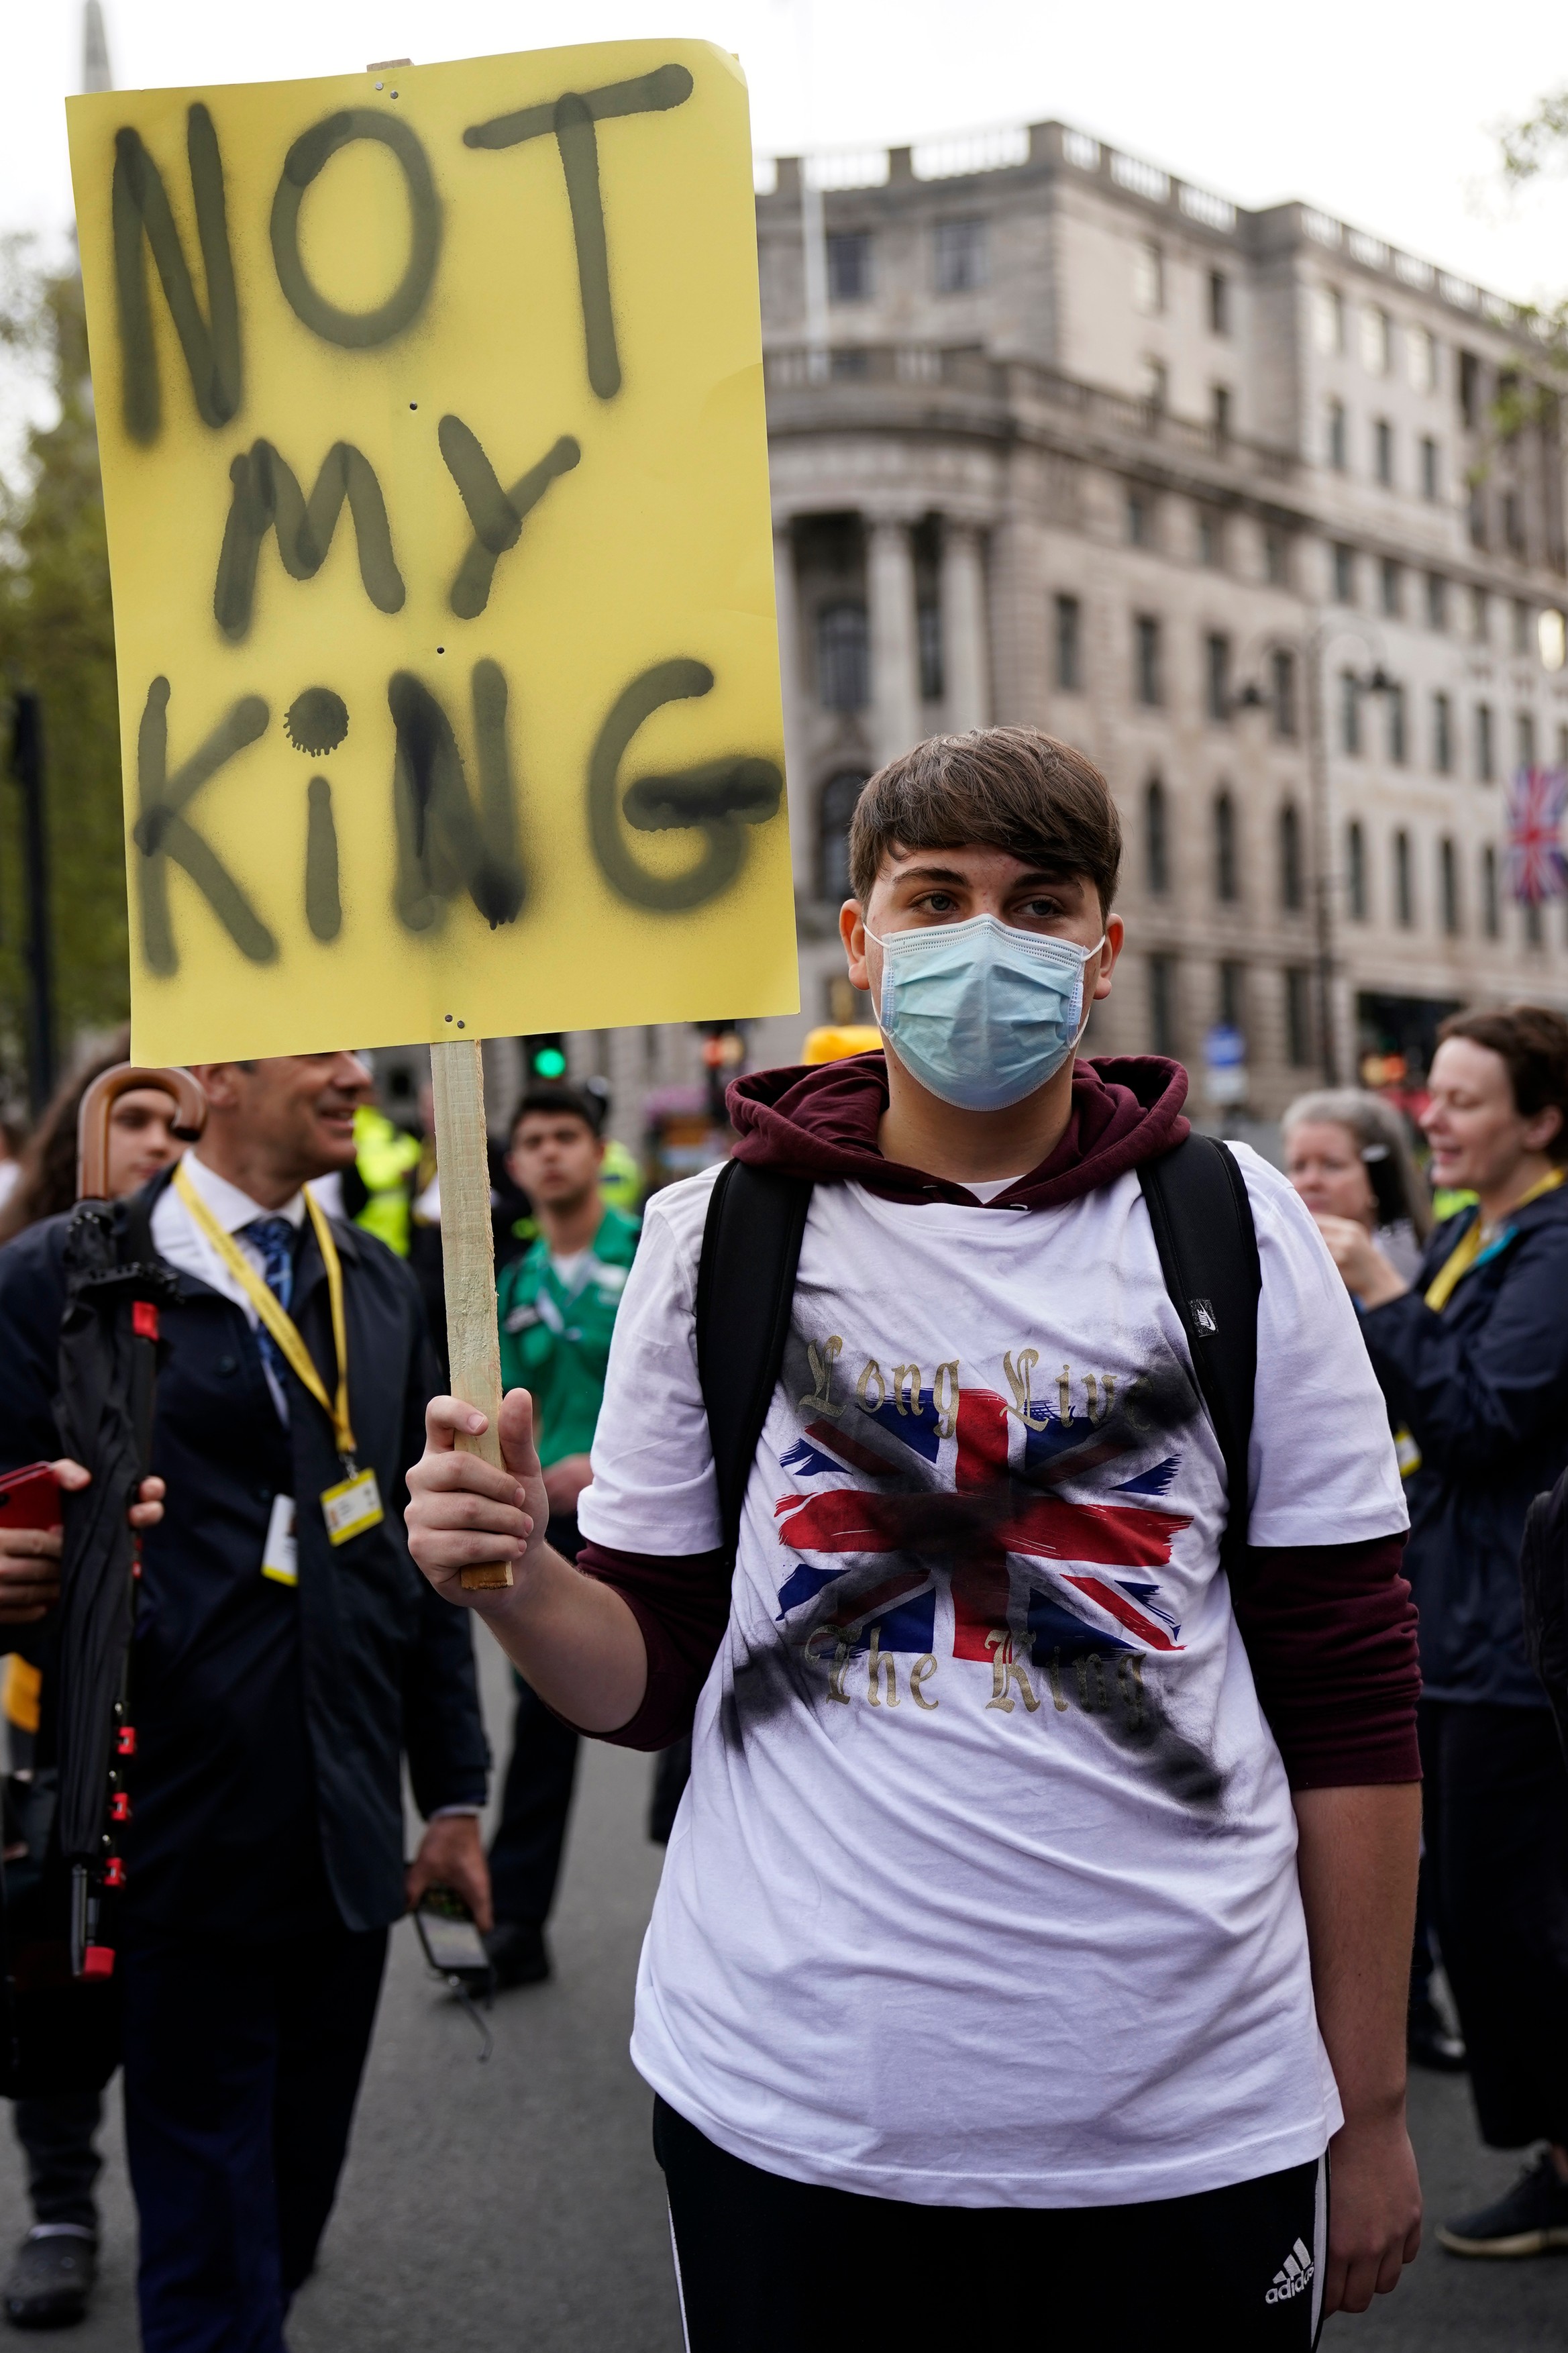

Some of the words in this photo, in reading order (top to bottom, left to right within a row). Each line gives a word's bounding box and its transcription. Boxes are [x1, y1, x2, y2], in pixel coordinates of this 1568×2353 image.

[111, 64, 694, 448] NOT
[216, 415, 581, 641] MY
[1197, 1309, 1210, 1327] NIKE
[796, 1335, 959, 1439] Long
[1000, 1349, 1153, 1432] Live
[805, 1624, 939, 1710] The
[984, 1630, 1146, 1731] King
